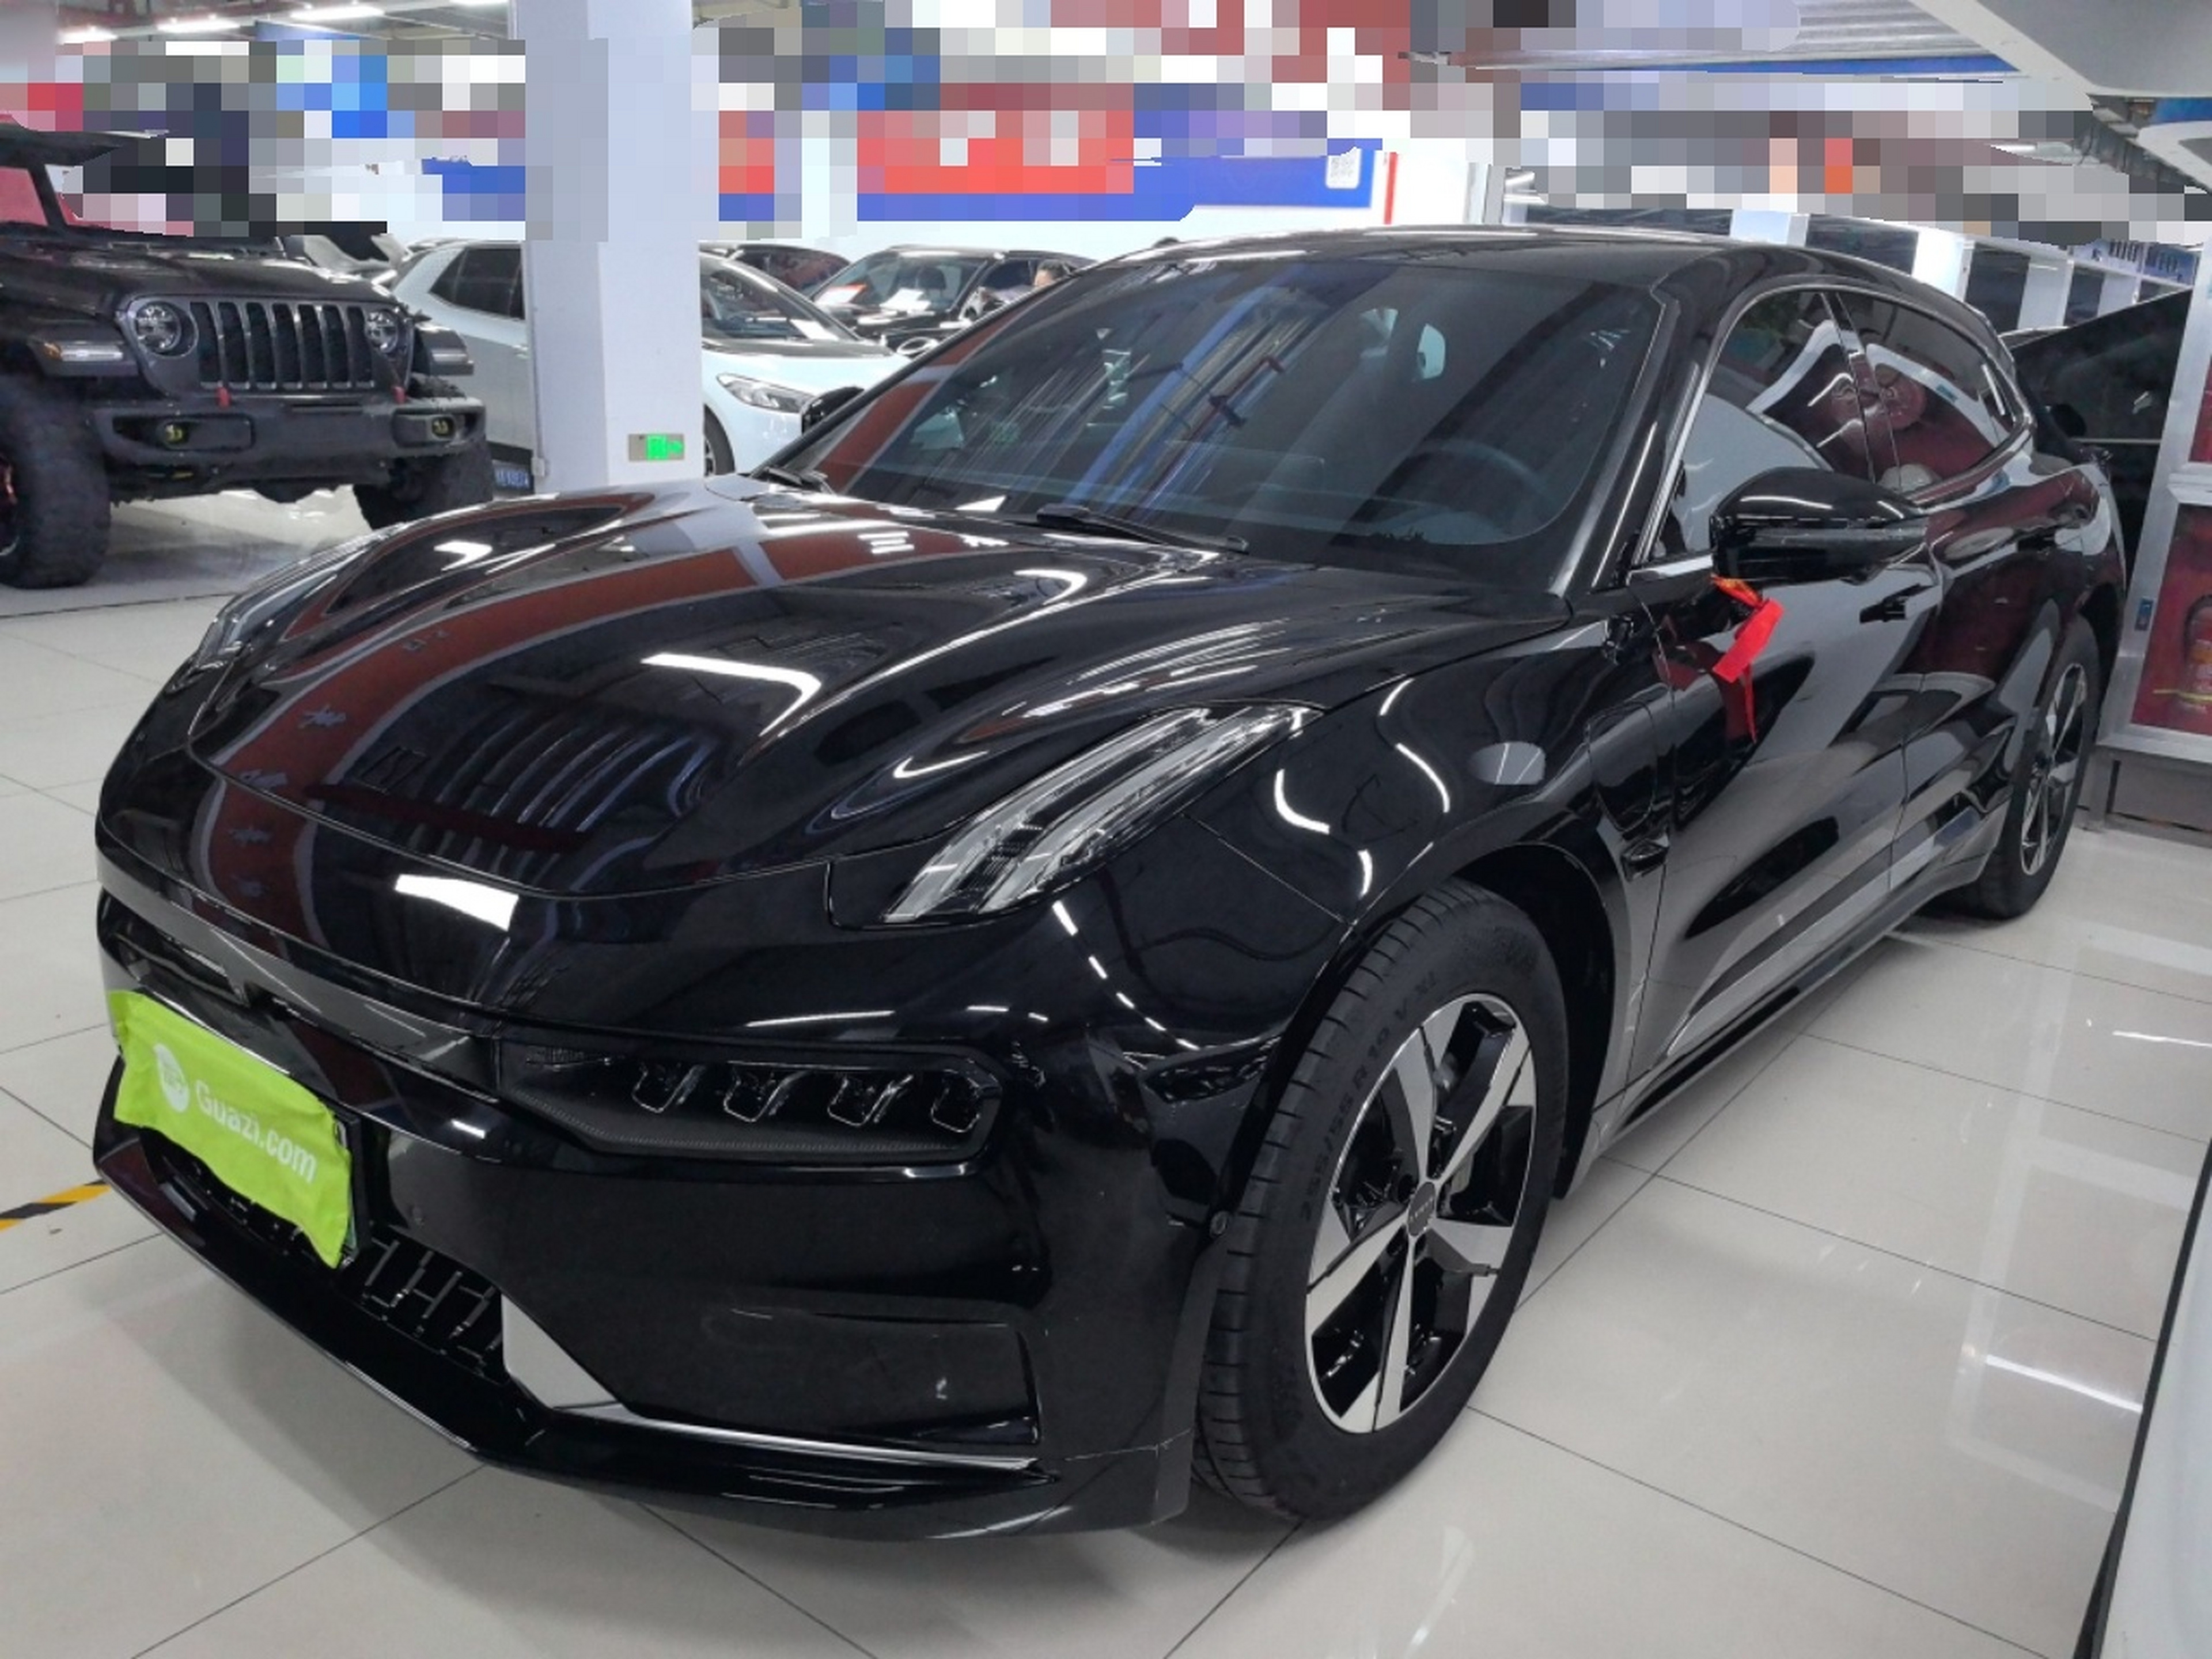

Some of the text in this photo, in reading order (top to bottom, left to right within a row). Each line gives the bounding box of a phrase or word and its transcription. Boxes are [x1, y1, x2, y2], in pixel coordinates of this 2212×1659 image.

[196, 1080, 318, 1184] Guazi.com
[1300, 1092, 1354, 1221] 255/55
[1353, 1064, 1368, 1090] R
